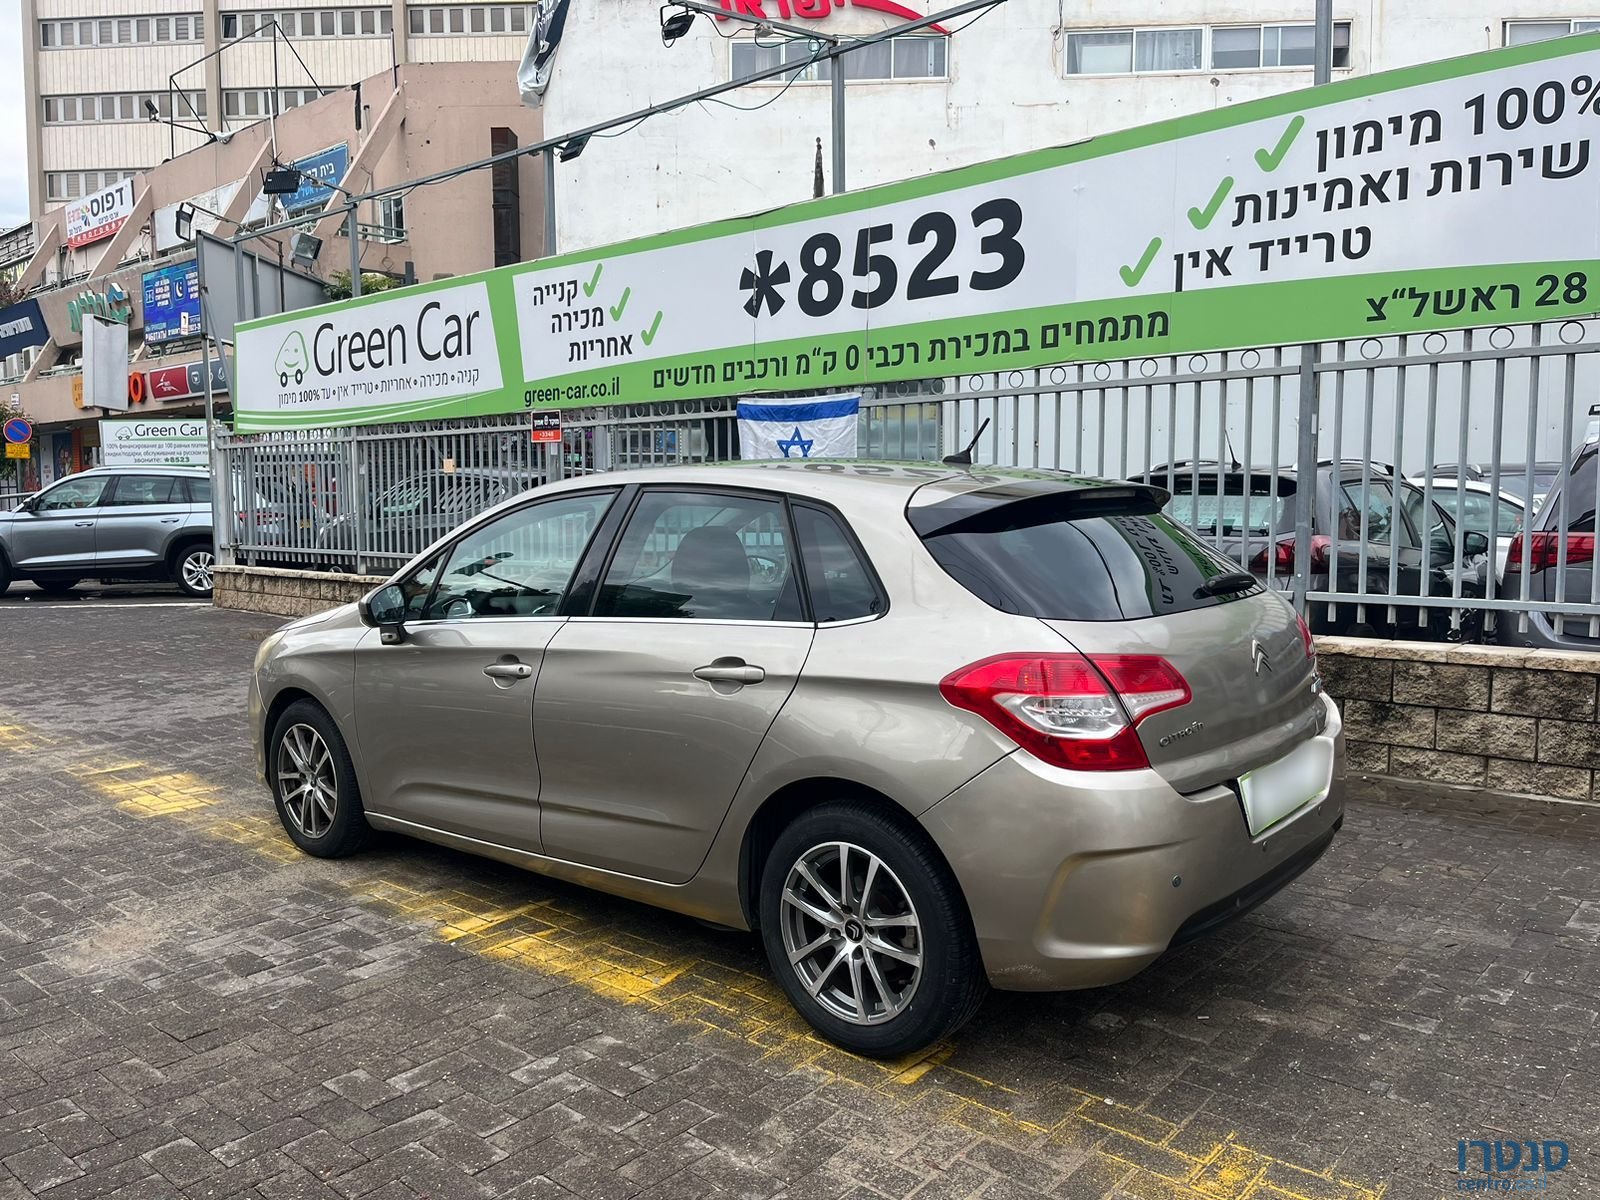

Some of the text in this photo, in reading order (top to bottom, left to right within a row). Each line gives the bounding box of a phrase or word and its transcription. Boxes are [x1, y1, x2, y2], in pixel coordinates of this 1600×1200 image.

[1316, 108, 1442, 172] מימון
[320, 162, 335, 177] בית
[1231, 139, 1590, 228] שירות ואמינות
[90, 187, 124, 217] דפוס
[1173, 225, 1372, 293] טרייד אין
[532, 278, 579, 307] קנייה
[1366, 271, 1589, 323] 28 ראשל"צ
[551, 306, 604, 335] מכירה
[313, 301, 480, 377] Green Car
[568, 333, 633, 363] אחריות
[652, 310, 1170, 390] מתמחים במכירת רכבי 0 ק"מ ורכבים חדשים
[278, 368, 479, 408] קניה מכירה אחריות טרייד אין עד 100% מימון
[523, 376, 620, 408] green-car.co.il
[135, 423, 203, 437] Green Car
